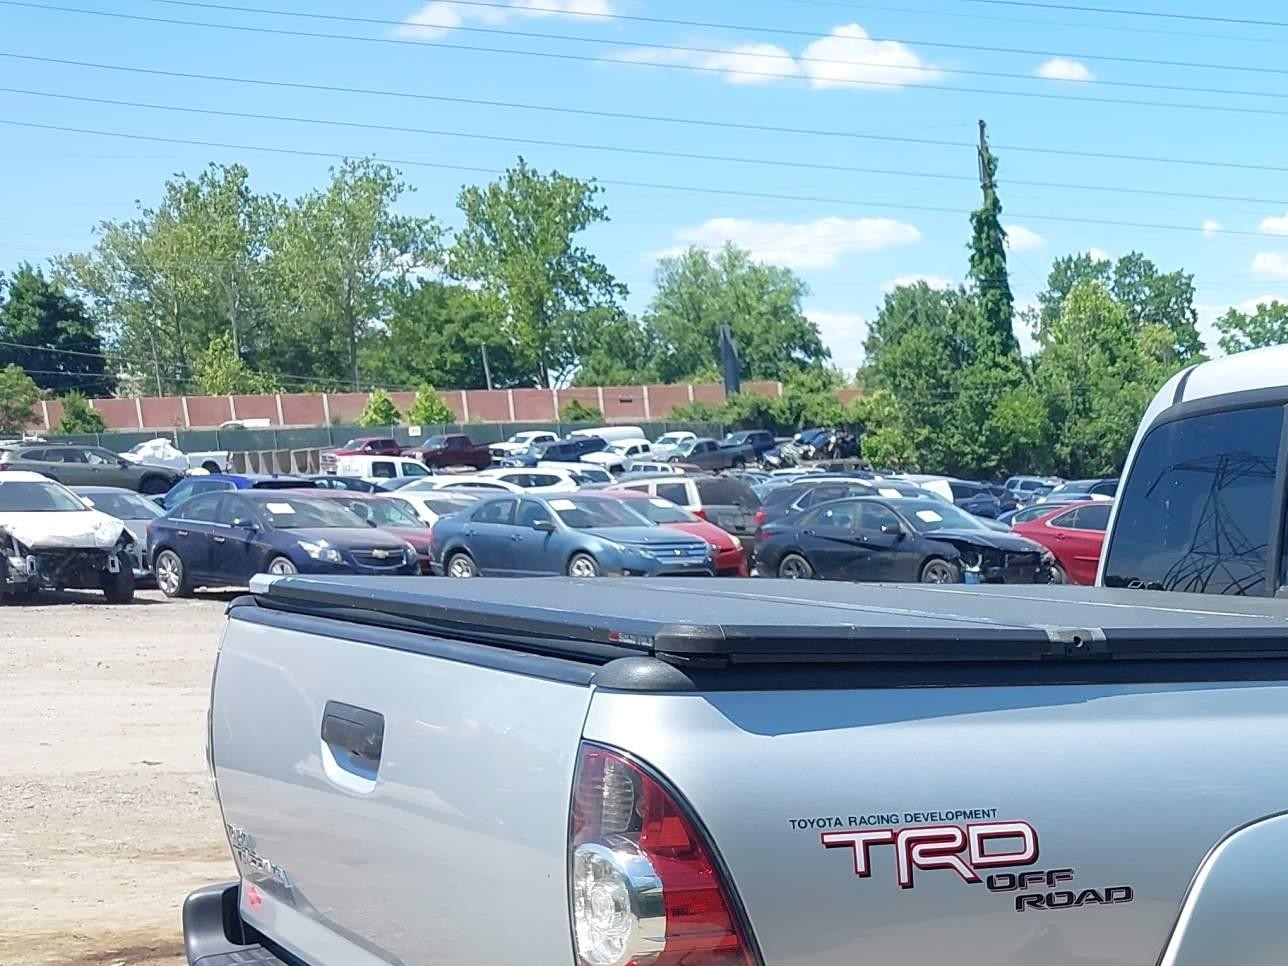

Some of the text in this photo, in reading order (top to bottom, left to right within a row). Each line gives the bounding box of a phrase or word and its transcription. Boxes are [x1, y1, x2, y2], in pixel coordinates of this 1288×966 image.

[789, 808, 998, 830] TOYOTA RACING DEVELOPMENT
[820, 820, 1040, 890] TRD
[986, 868, 1075, 893] OFF
[1014, 886, 1135, 912] ROAD
